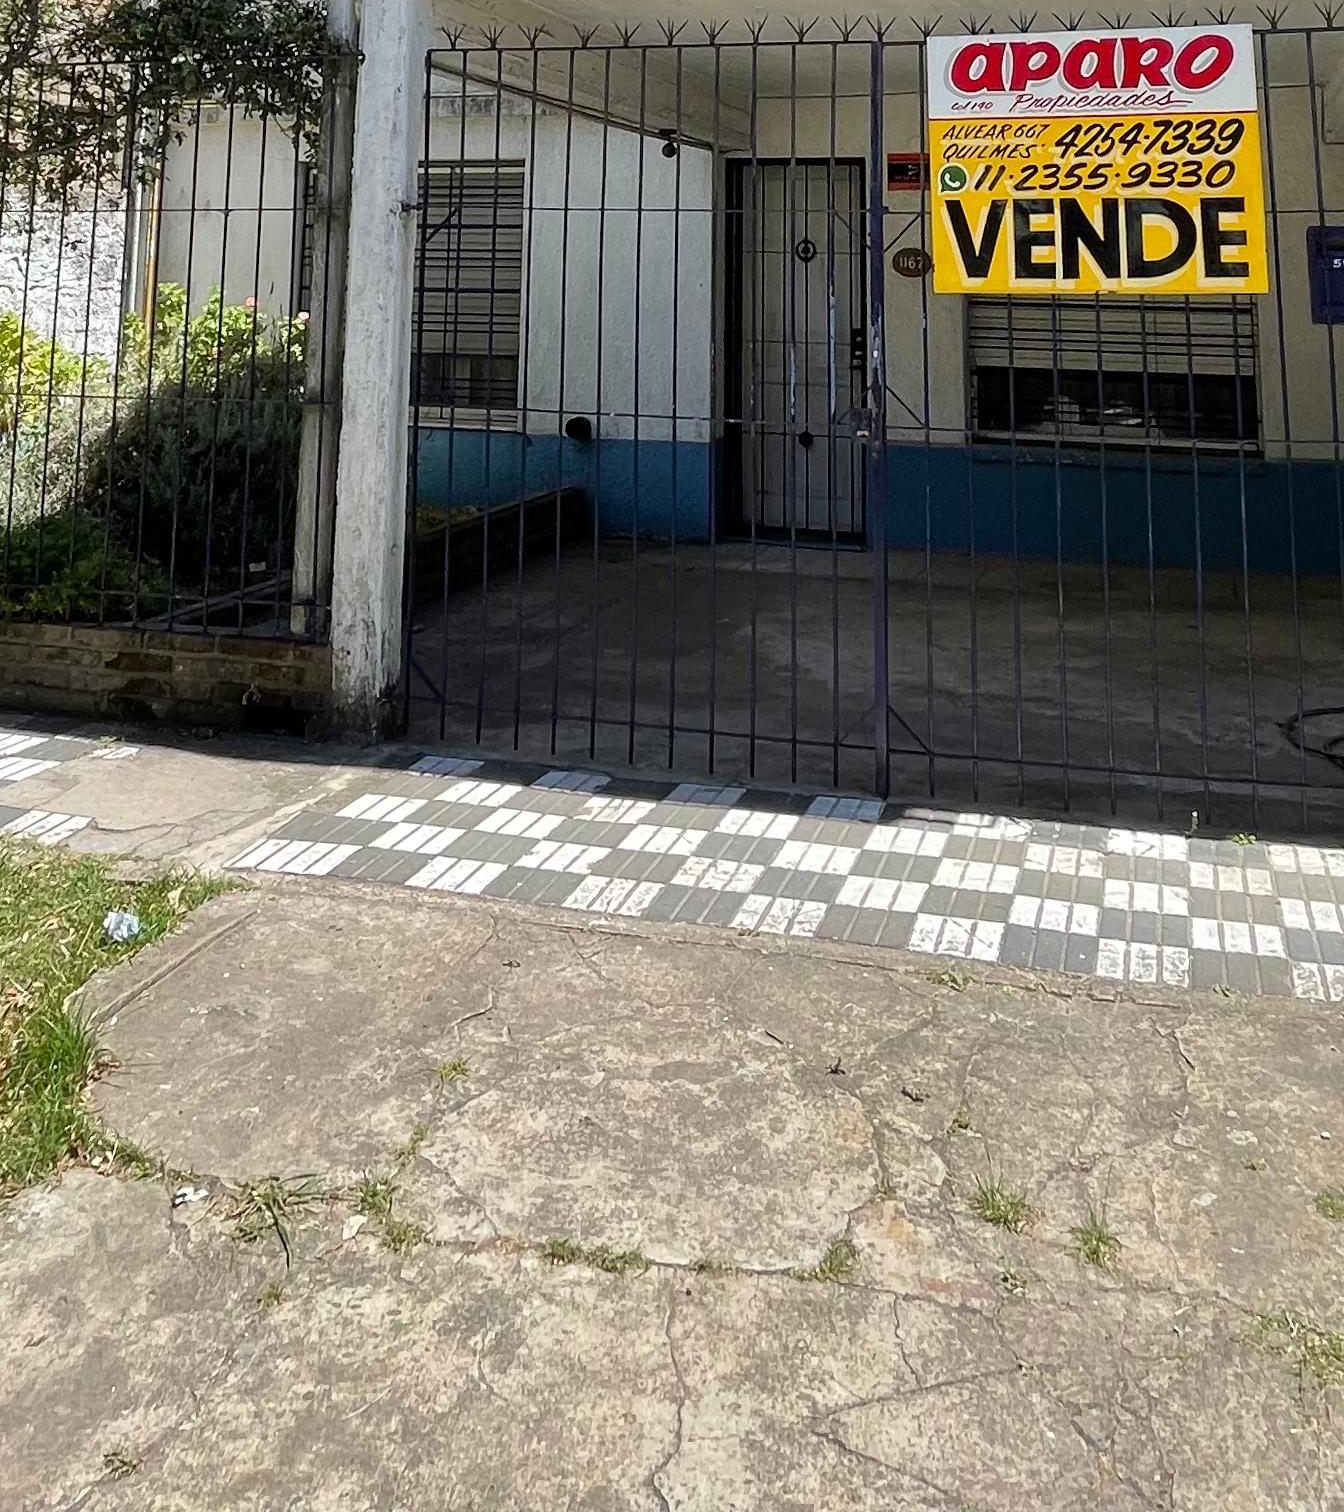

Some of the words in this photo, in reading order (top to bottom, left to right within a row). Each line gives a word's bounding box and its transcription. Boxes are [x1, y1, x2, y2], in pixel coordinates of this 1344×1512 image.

[1009, 90, 1193, 113] Propiedades
[942, 124, 1013, 141] ALVEAR
[1013, 123, 1051, 140] 667
[942, 143, 1038, 163] QUILMES
[944, 196, 1250, 279] VENDE
[899, 256, 925, 269] 1167
